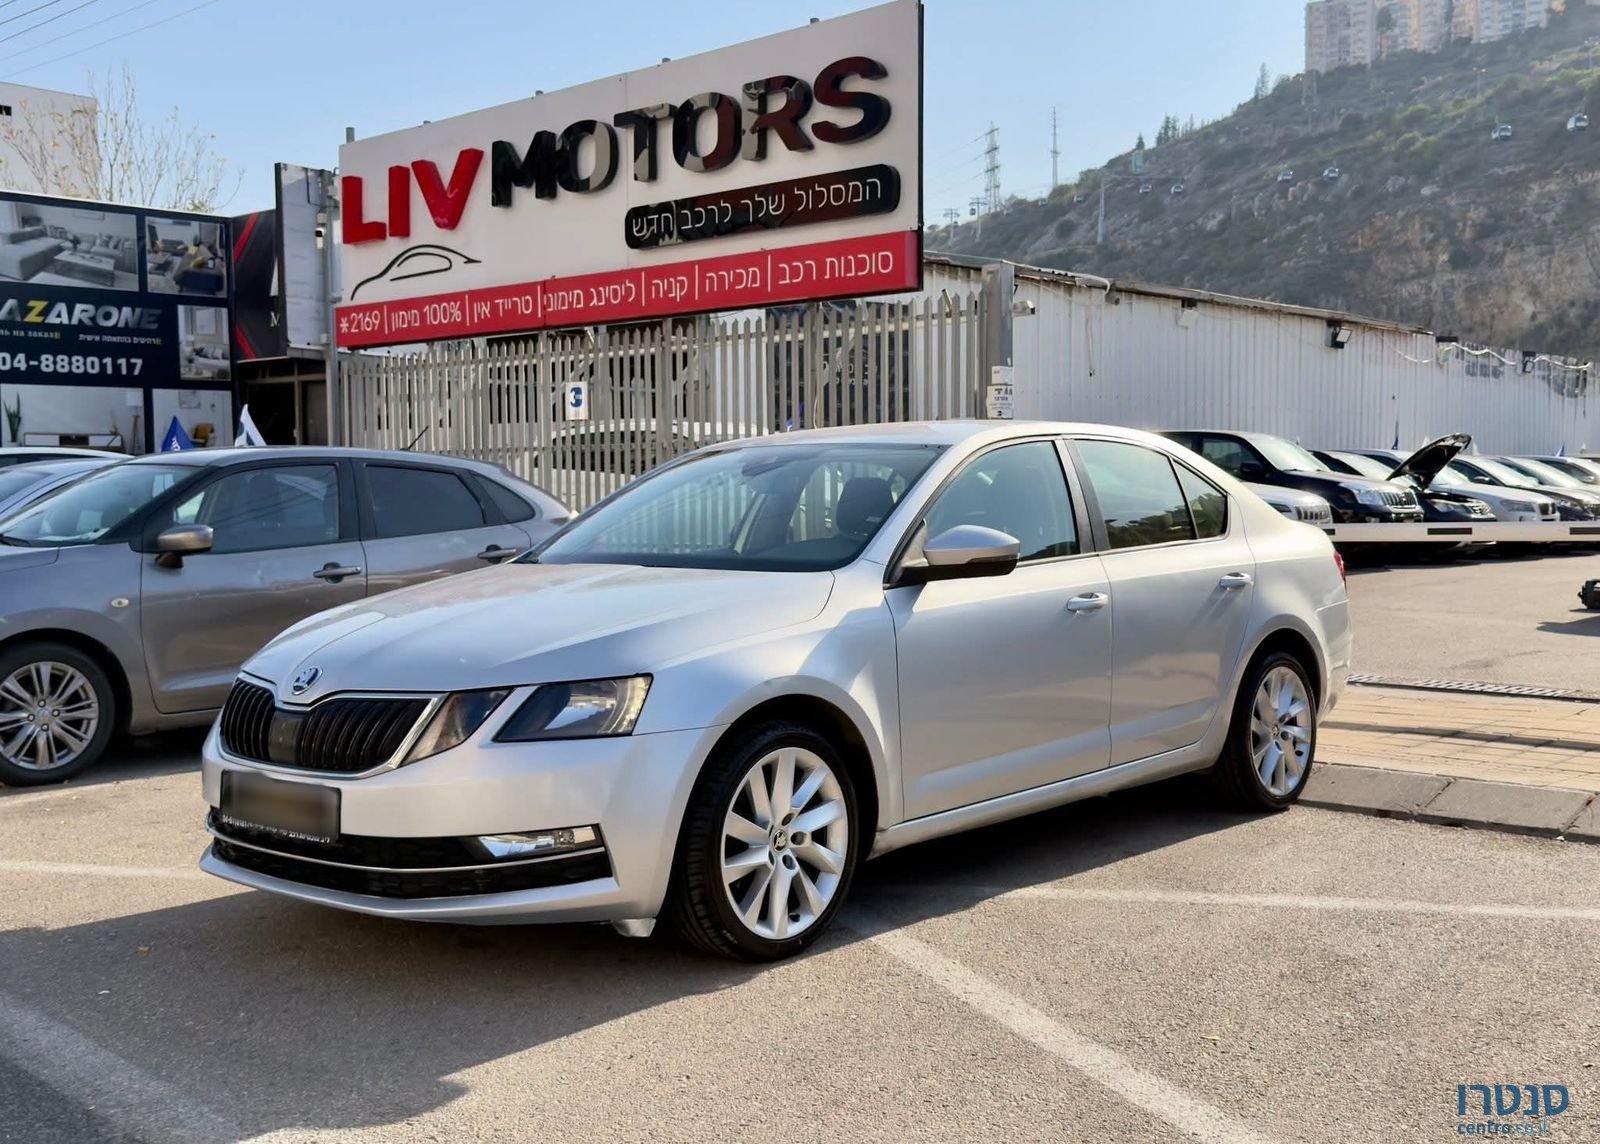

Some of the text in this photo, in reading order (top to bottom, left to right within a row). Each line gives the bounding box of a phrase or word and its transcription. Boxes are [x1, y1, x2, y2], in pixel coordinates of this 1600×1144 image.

[342, 56, 891, 245] LIV MOTORS
[633, 178, 881, 237] המסלול שלך לרכב חדש
[778, 260, 816, 285] רכב
[824, 250, 893, 280] סוכנות
[651, 275, 688, 302] קניה
[705, 266, 760, 293] מכירה
[544, 289, 584, 312] מימוני
[589, 279, 636, 307] ליסינג
[0, 299, 162, 330] AZARONE
[423, 301, 461, 325] 100%
[474, 300, 491, 324] אין
[495, 295, 533, 318] טרייד
[391, 309, 420, 331] מימון
[0, 352, 143, 376] 04-8880117
